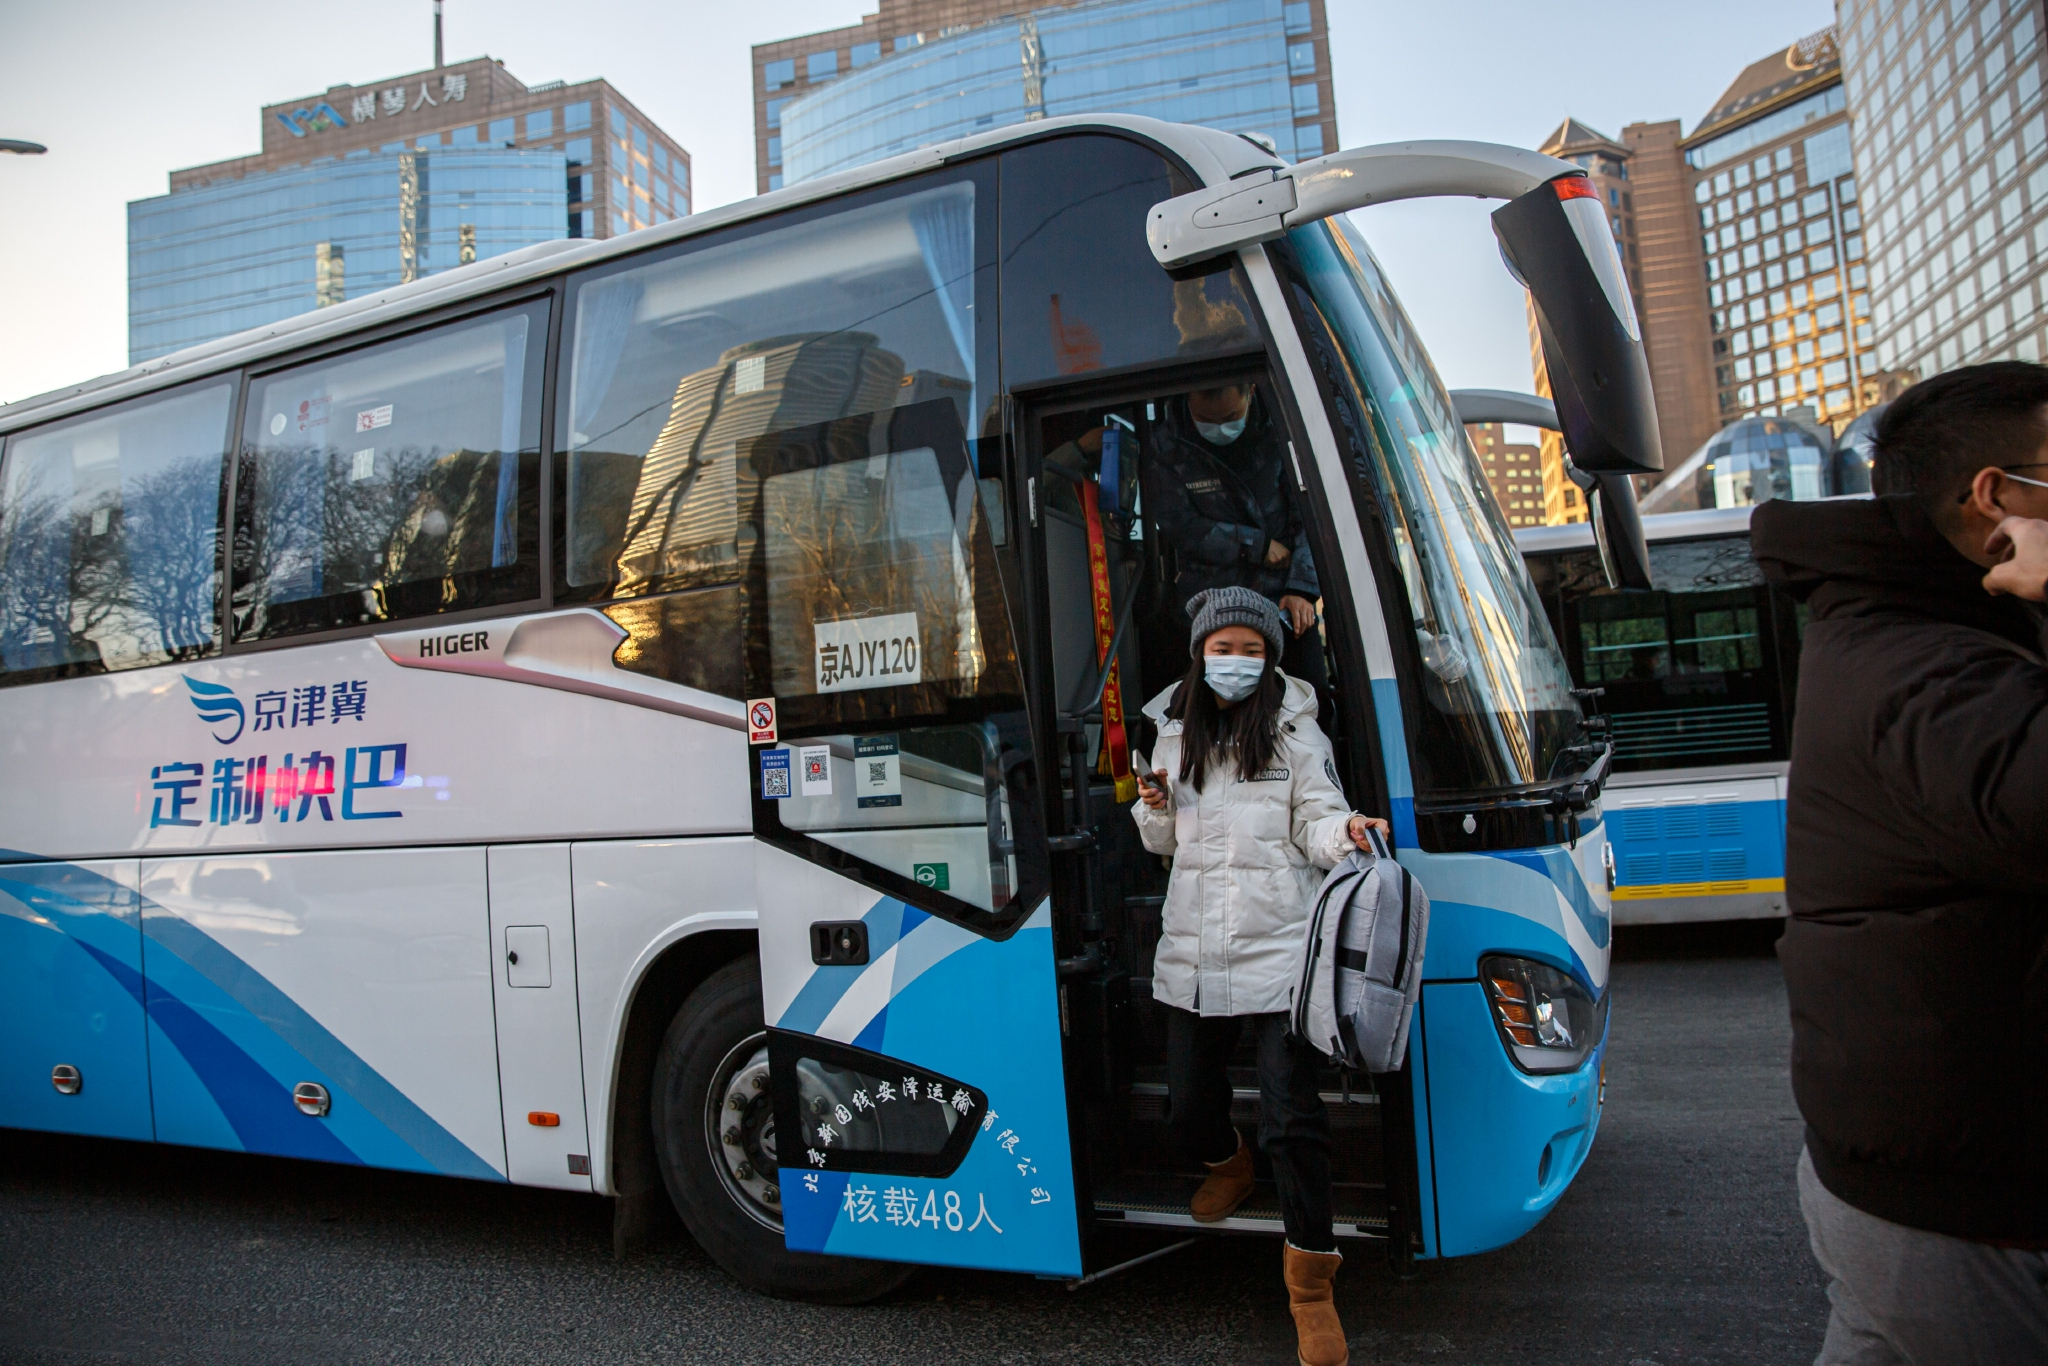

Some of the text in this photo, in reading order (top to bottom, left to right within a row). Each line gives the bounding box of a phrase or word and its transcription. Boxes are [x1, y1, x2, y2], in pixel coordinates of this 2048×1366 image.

[351, 74, 468, 124] 横琴人寿
[420, 631, 490, 658] HIGER
[1094, 542, 1119, 722] 京津冀定制快欢迎您
[819, 636, 917, 687] 京AJY120
[253, 680, 368, 732] 京津冀
[150, 743, 408, 829] 定制快巴
[843, 1184, 1003, 1234] 核载48人
